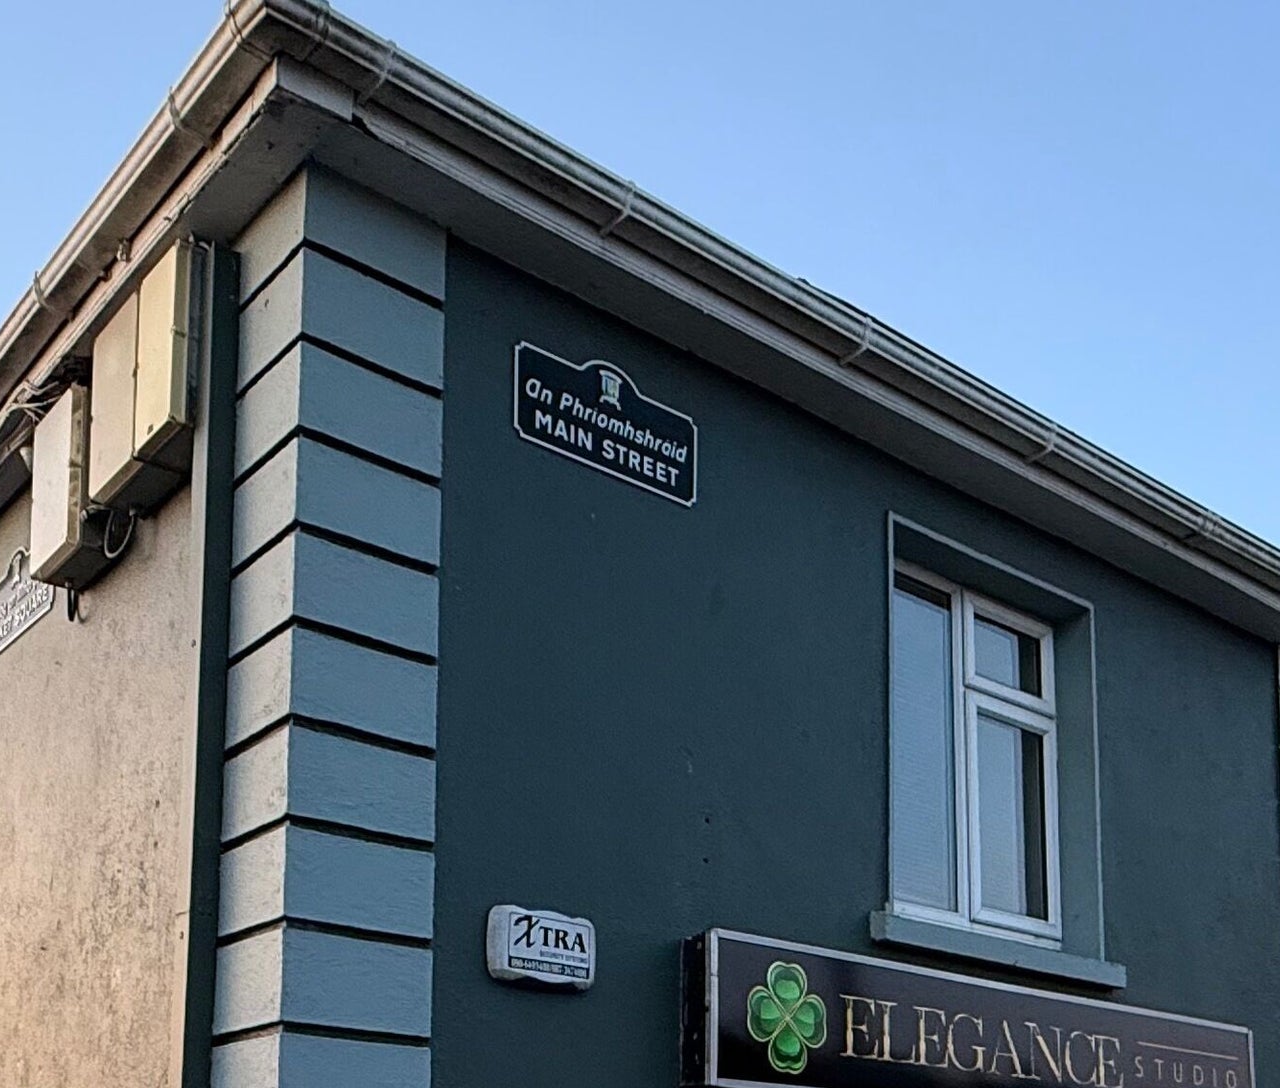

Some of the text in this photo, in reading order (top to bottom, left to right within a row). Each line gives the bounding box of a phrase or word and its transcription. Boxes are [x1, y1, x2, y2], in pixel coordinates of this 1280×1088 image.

[534, 409, 680, 487] MAIN STREET
[513, 914, 587, 954] XTRA
